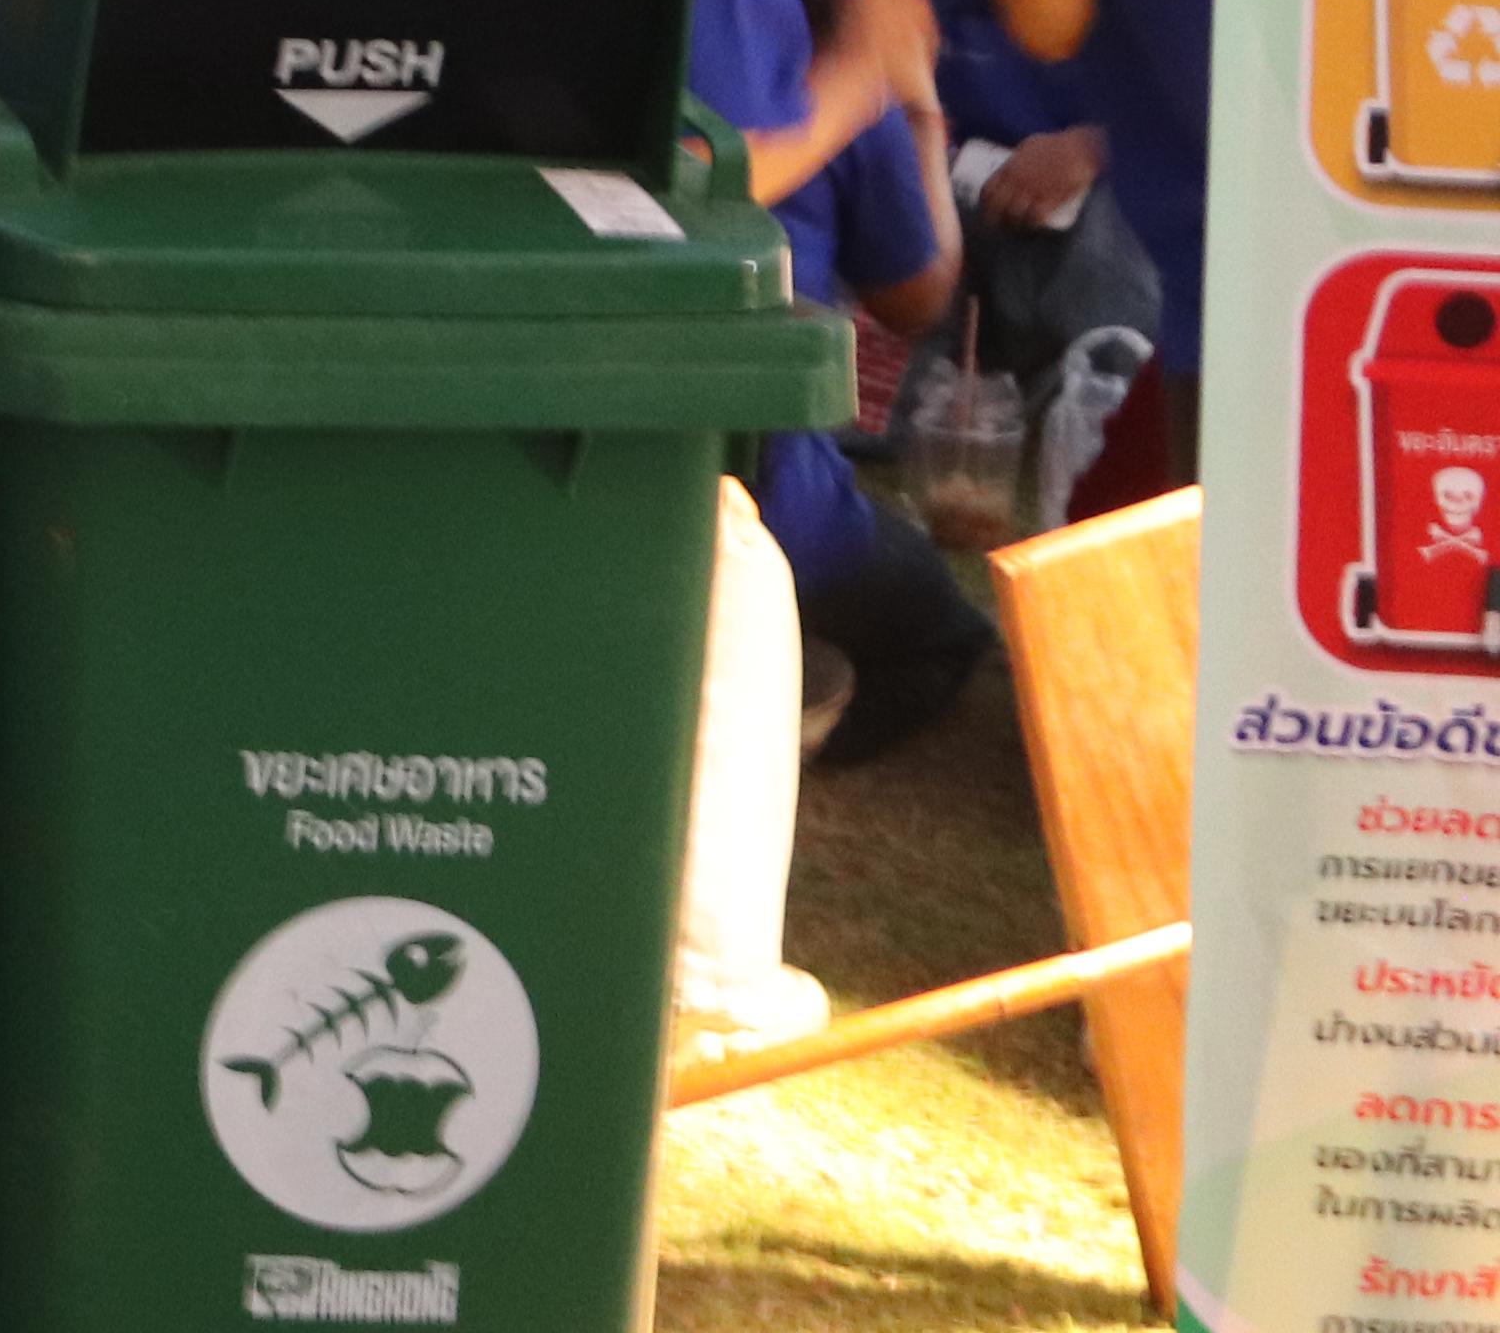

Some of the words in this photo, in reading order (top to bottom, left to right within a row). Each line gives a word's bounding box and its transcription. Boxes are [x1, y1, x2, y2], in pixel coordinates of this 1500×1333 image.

[276, 36, 443, 90] PUSH
[239, 750, 548, 805] ขยะเศษอาหาร
[286, 809, 380, 852] Food
[387, 813, 495, 858] Waste
